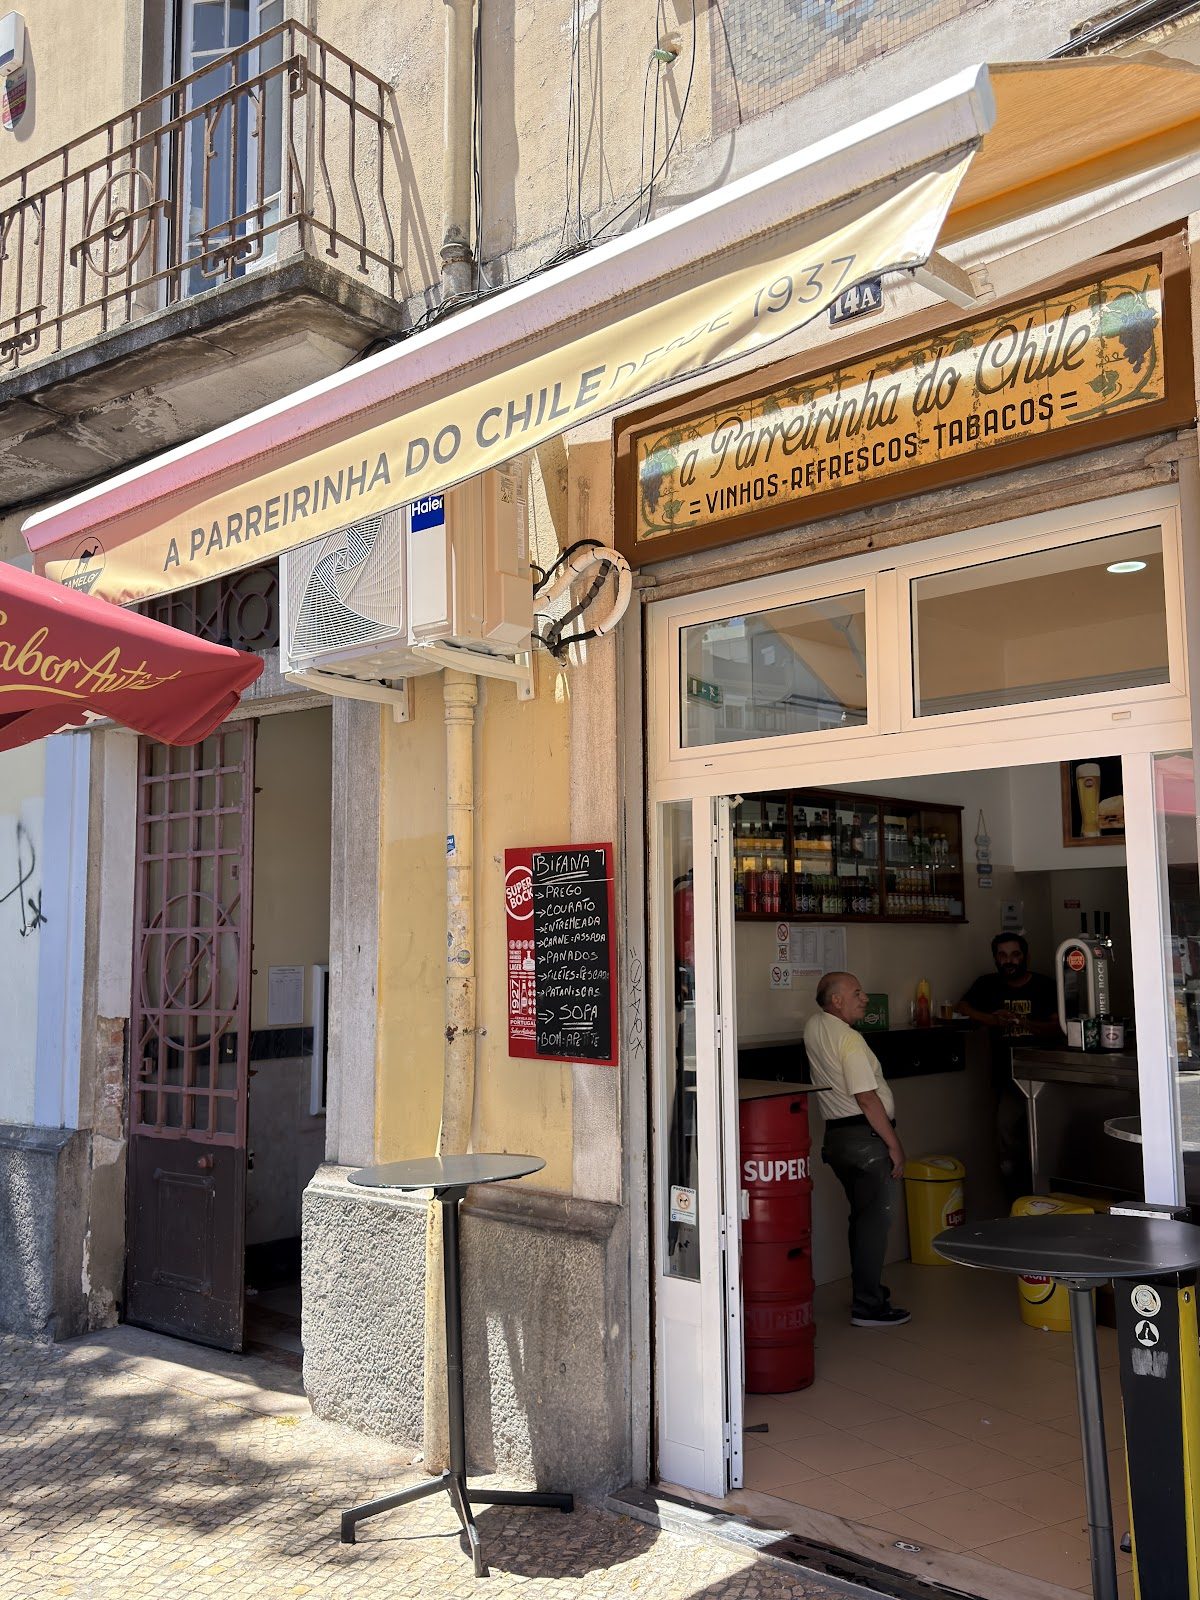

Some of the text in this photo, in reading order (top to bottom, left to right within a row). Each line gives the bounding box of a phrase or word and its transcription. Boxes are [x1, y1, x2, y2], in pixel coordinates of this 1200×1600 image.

[680, 304, 1091, 488] a Parreirinha do Chile
[163, 537, 180, 572] A
[189, 452, 391, 560] PARREIRINHA
[405, 424, 462, 477] DO
[476, 364, 607, 449] CHILE
[753, 254, 857, 318] 1937
[411, 497, 443, 517] Haier
[0, 610, 80, 684] abor
[505, 876, 533, 899] SUPER
[509, 887, 534, 909] BOCK
[545, 884, 582, 899] PREGO
[544, 916, 601, 934] ENTREMEADA
[546, 950, 599, 964] PANADOS
[511, 979, 520, 1015] 1927
[1098, 992, 1106, 1020] UPER
[559, 1003, 598, 1021] SOPA
[743, 1157, 807, 1183] SUPER
